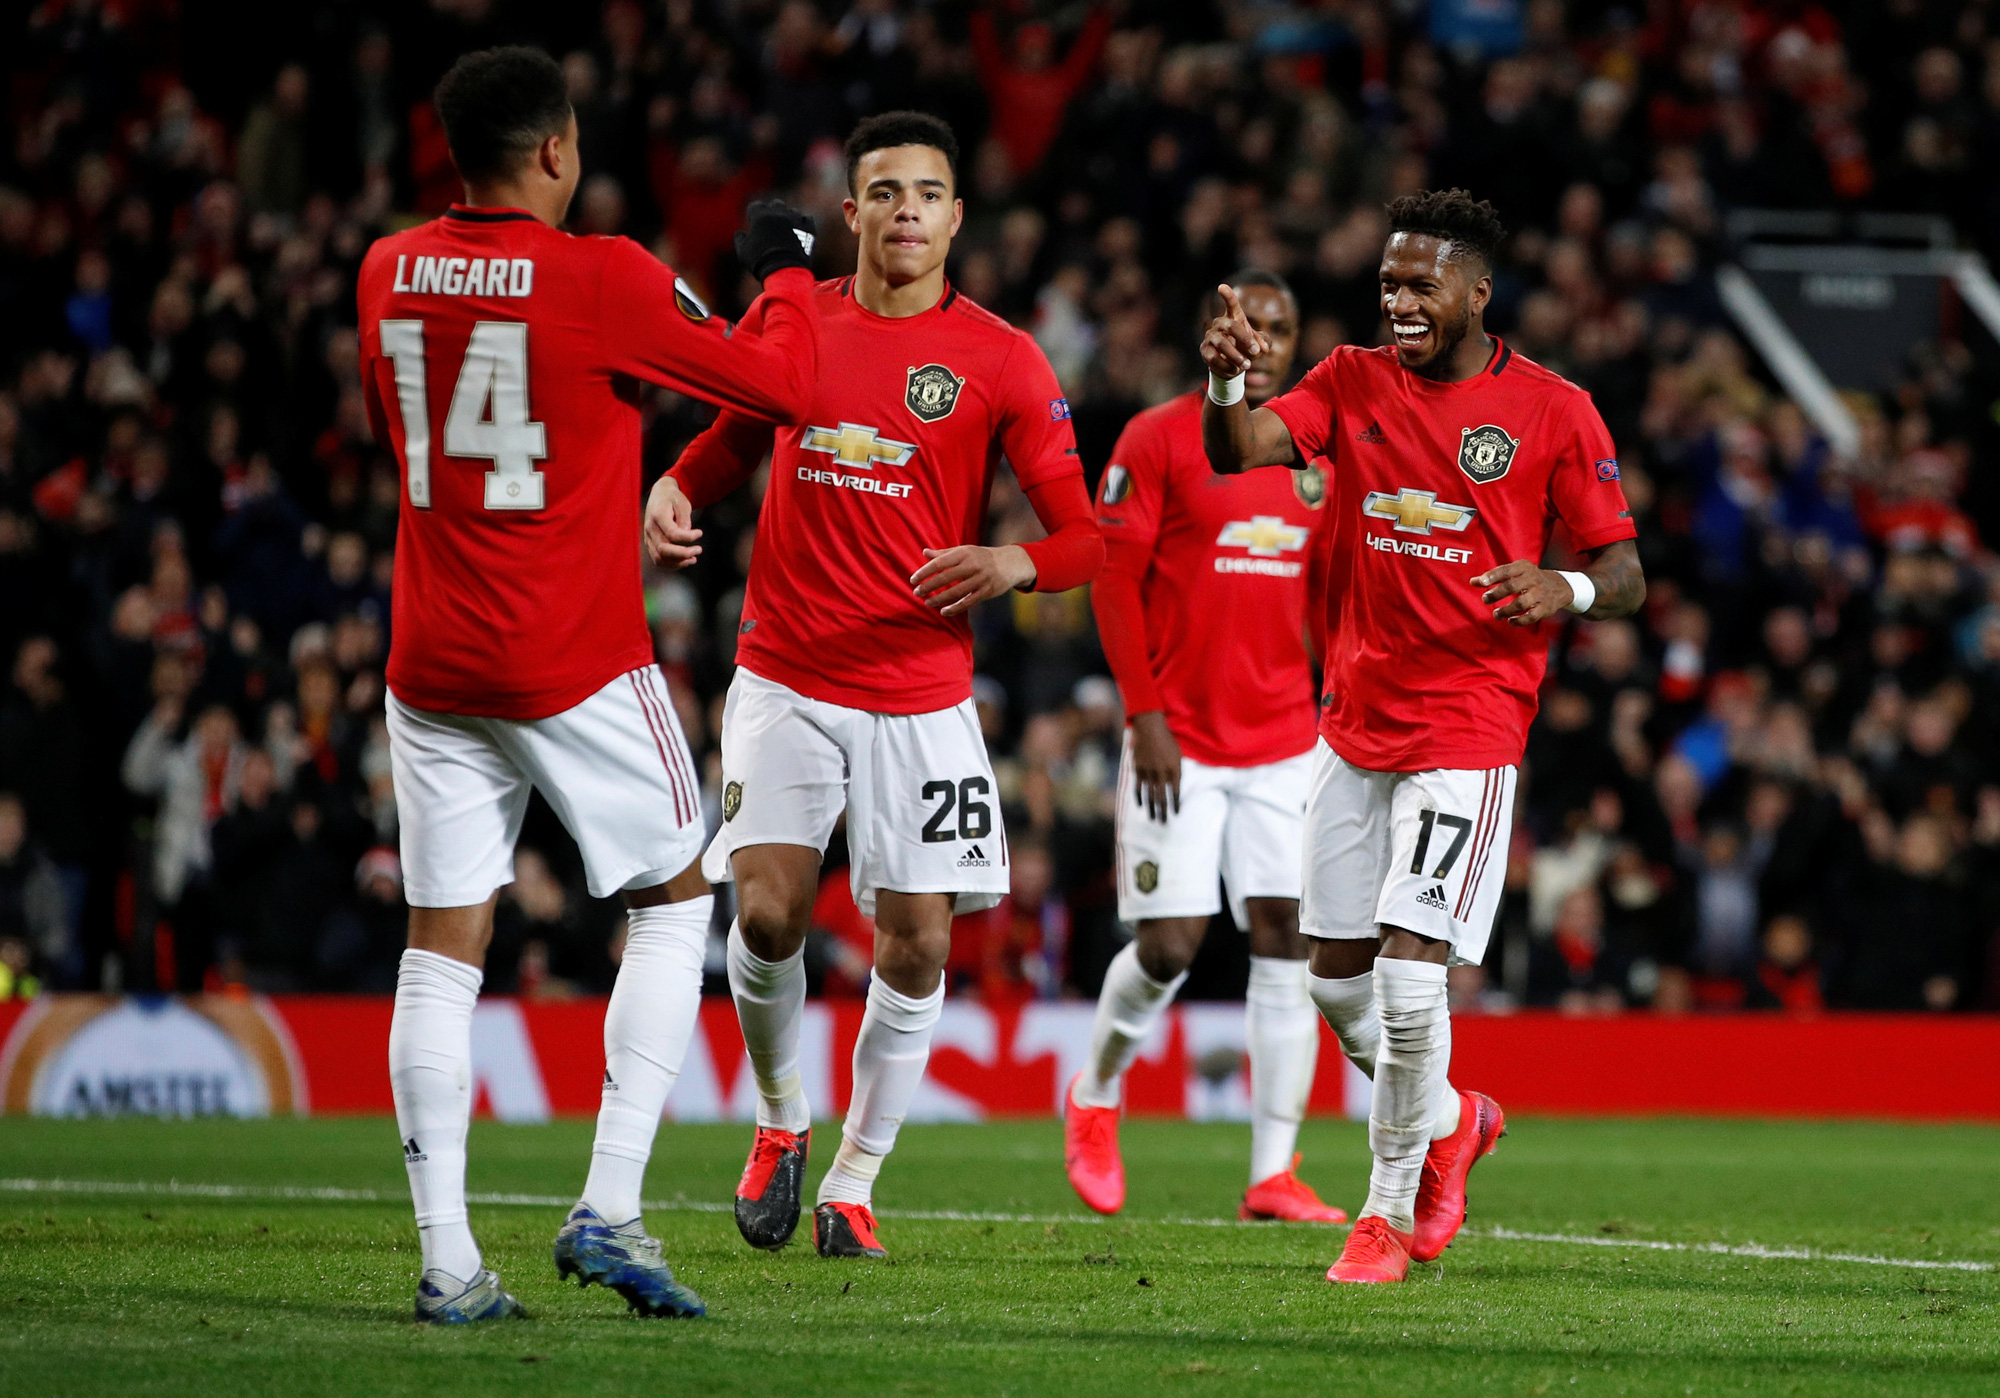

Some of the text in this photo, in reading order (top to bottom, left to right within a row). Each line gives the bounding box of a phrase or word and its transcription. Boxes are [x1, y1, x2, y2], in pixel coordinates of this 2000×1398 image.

[393, 255, 534, 298] LINGARD
[379, 319, 546, 510] 14
[797, 466, 914, 498] CHEVROLET
[921, 775, 992, 843] 26
[956, 859, 991, 868] adidas
[1409, 808, 1474, 881] 17
[1415, 894, 1449, 912] adidas
